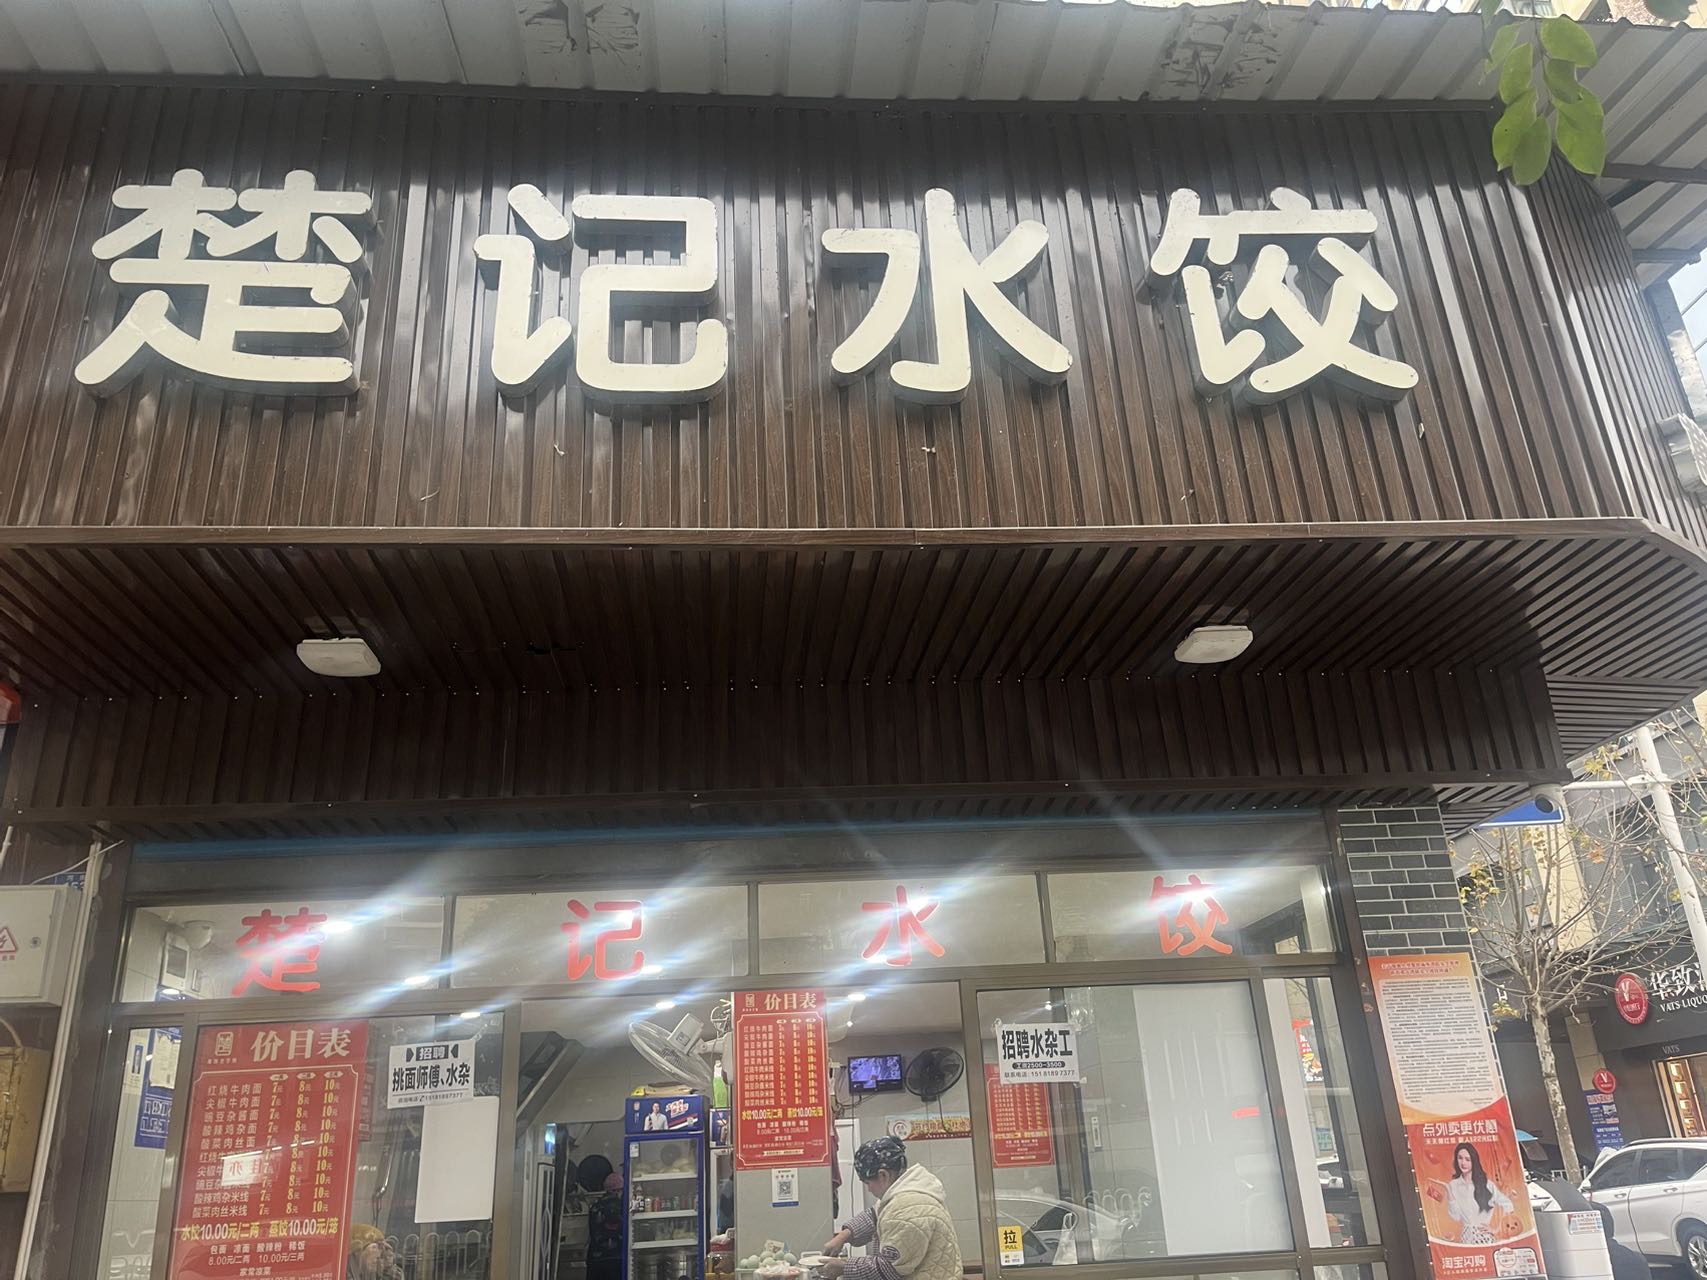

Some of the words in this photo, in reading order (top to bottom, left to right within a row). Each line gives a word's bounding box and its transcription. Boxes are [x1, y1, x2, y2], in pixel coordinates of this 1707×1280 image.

[74, 168, 1419, 395] 楚记水饺
[230, 877, 1233, 997] 楚记水饺
[764, 993, 817, 1011] 价目表
[1660, 1000, 1680, 1012] VATS
[251, 1028, 351, 1062] 价目表
[1002, 1028, 1073, 1060] 招聘水杂工
[1662, 1044, 1680, 1055] VATS
[419, 1047, 446, 1060] 招聘
[1423, 1119, 1498, 1137] 点外卖更优惠
[1003, 1230, 1017, 1244] 拉
[1441, 1255, 1486, 1270] 淘宝闪购
